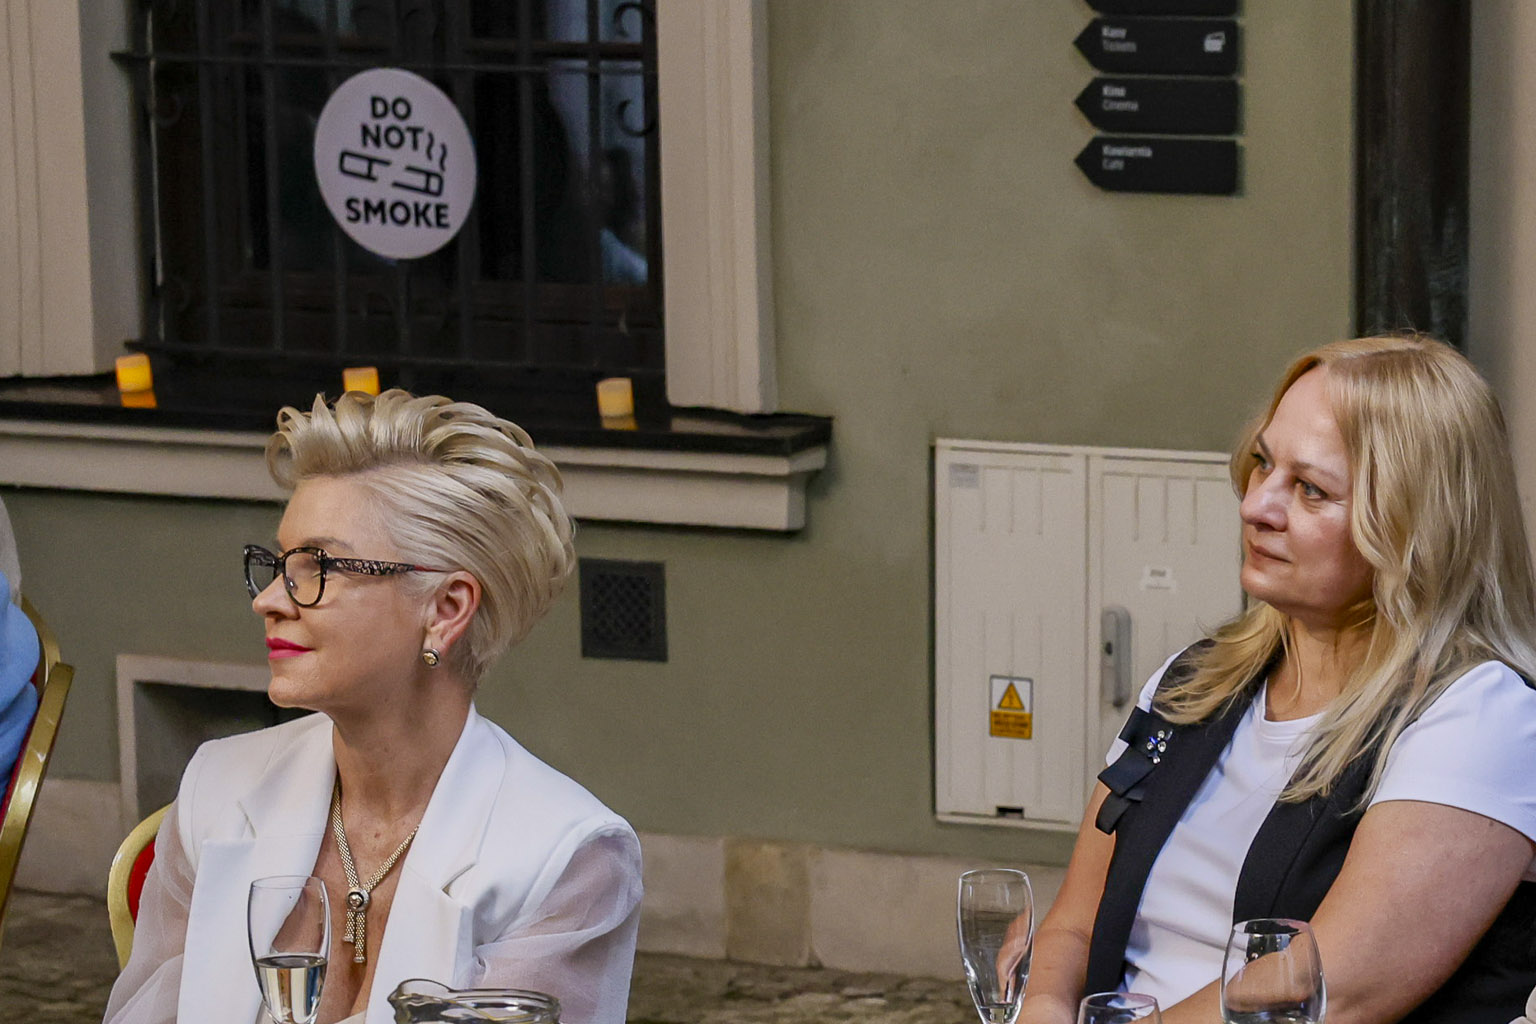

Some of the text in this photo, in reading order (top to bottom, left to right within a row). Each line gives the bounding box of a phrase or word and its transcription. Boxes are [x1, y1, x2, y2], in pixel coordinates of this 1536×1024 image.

[371, 96, 411, 120] DO
[361, 123, 424, 151] NOT
[346, 198, 450, 228] SMOKE
